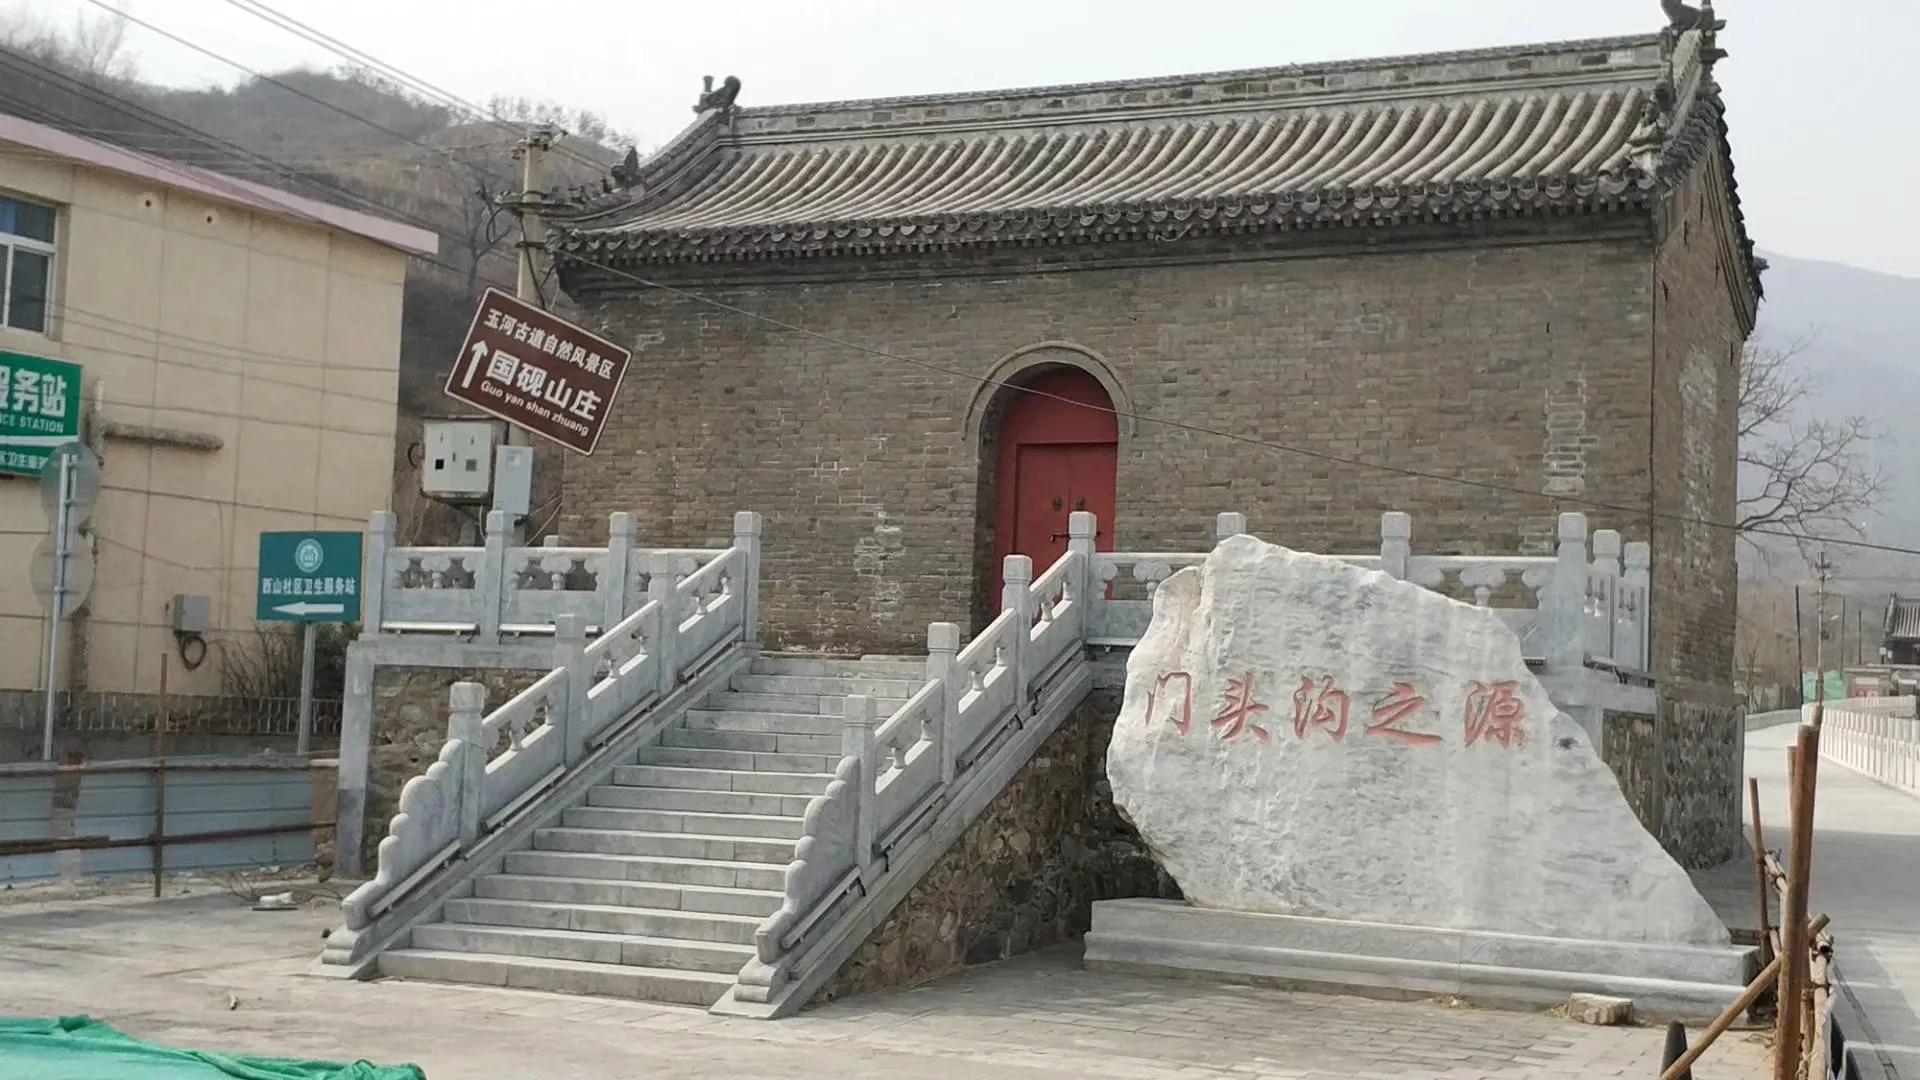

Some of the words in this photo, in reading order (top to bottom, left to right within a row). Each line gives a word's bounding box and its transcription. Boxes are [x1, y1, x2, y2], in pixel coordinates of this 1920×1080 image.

[483, 308, 615, 380] 玉河古道自然风景区
[481, 380, 504, 397] Guo
[504, 391, 524, 407] yan
[525, 400, 551, 418] shan
[551, 413, 589, 437] zhuang
[486, 349, 602, 421] 国砚山庄
[20, 416, 64, 433] STATION
[262, 577, 356, 596] 西山社区卫生服务站
[1145, 671, 1526, 750] 门头沟之源
